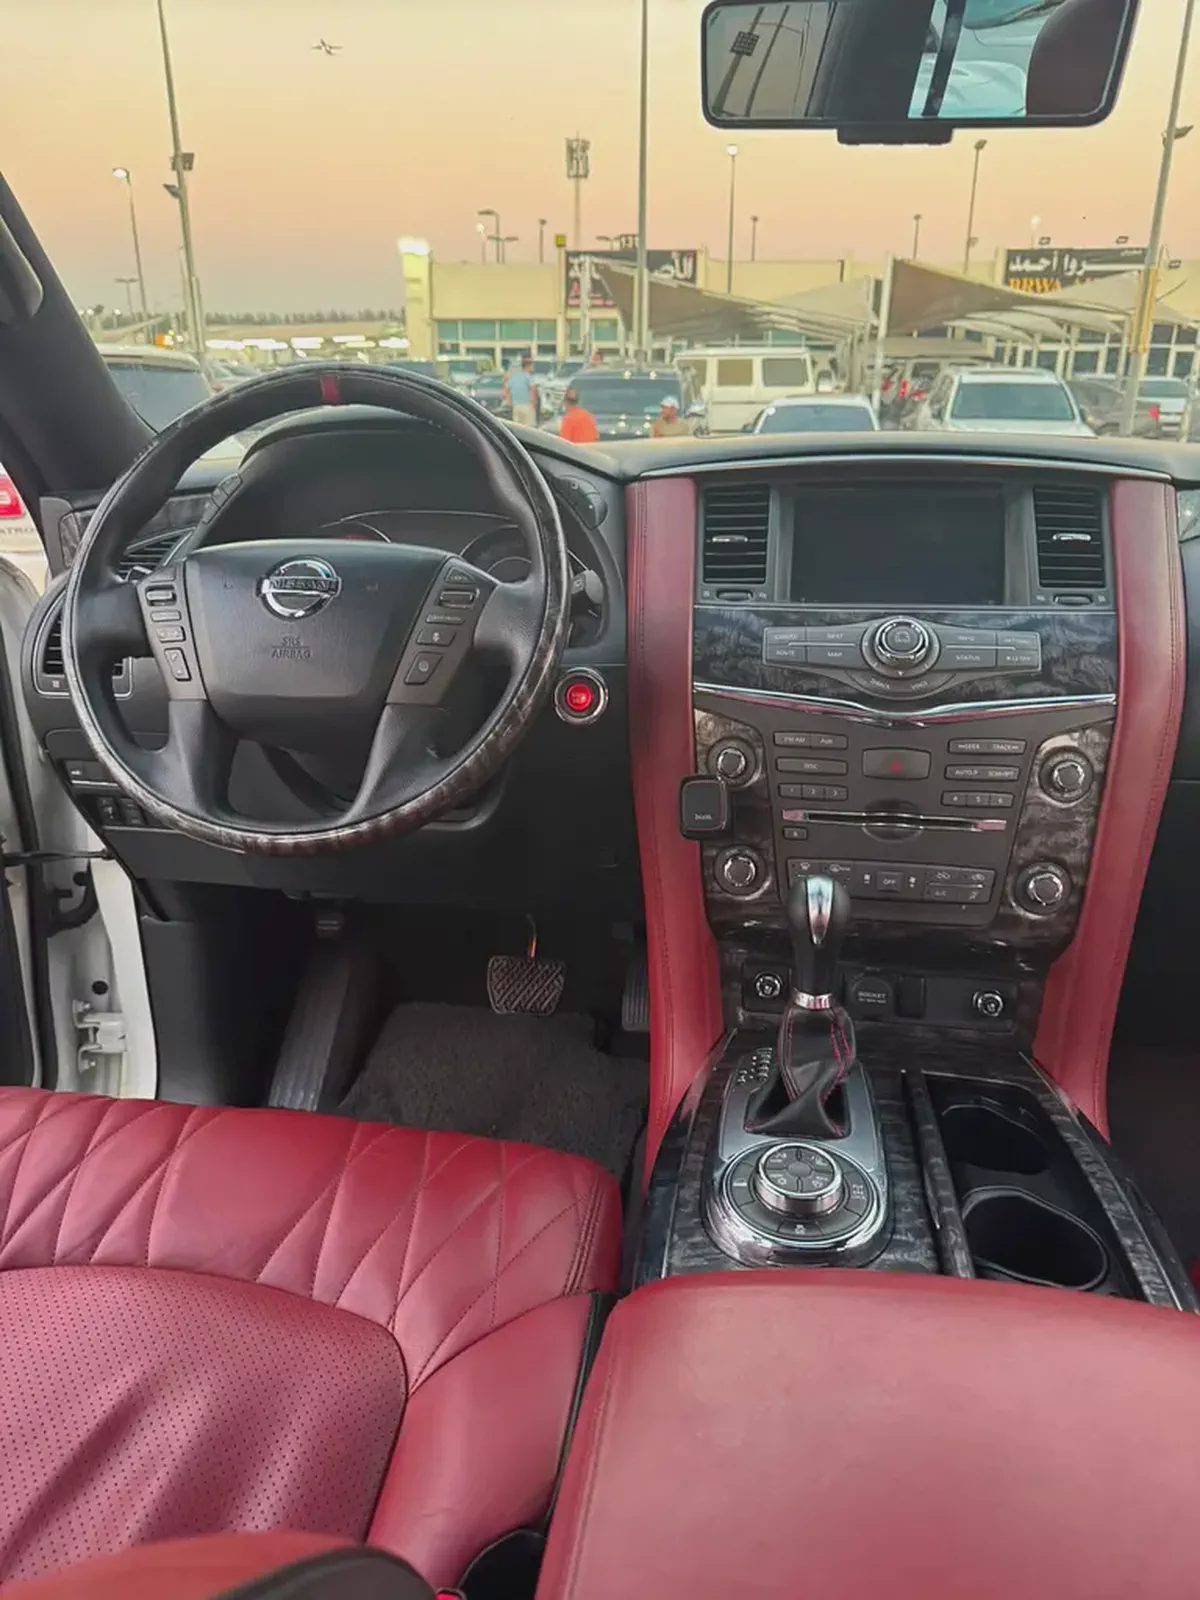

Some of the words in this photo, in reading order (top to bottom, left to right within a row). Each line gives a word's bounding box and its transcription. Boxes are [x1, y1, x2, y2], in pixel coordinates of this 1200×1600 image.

[1008, 250, 1058, 272] أحمد
[270, 579, 330, 591] NISSAN
[271, 649, 311, 660] AIRBAG
